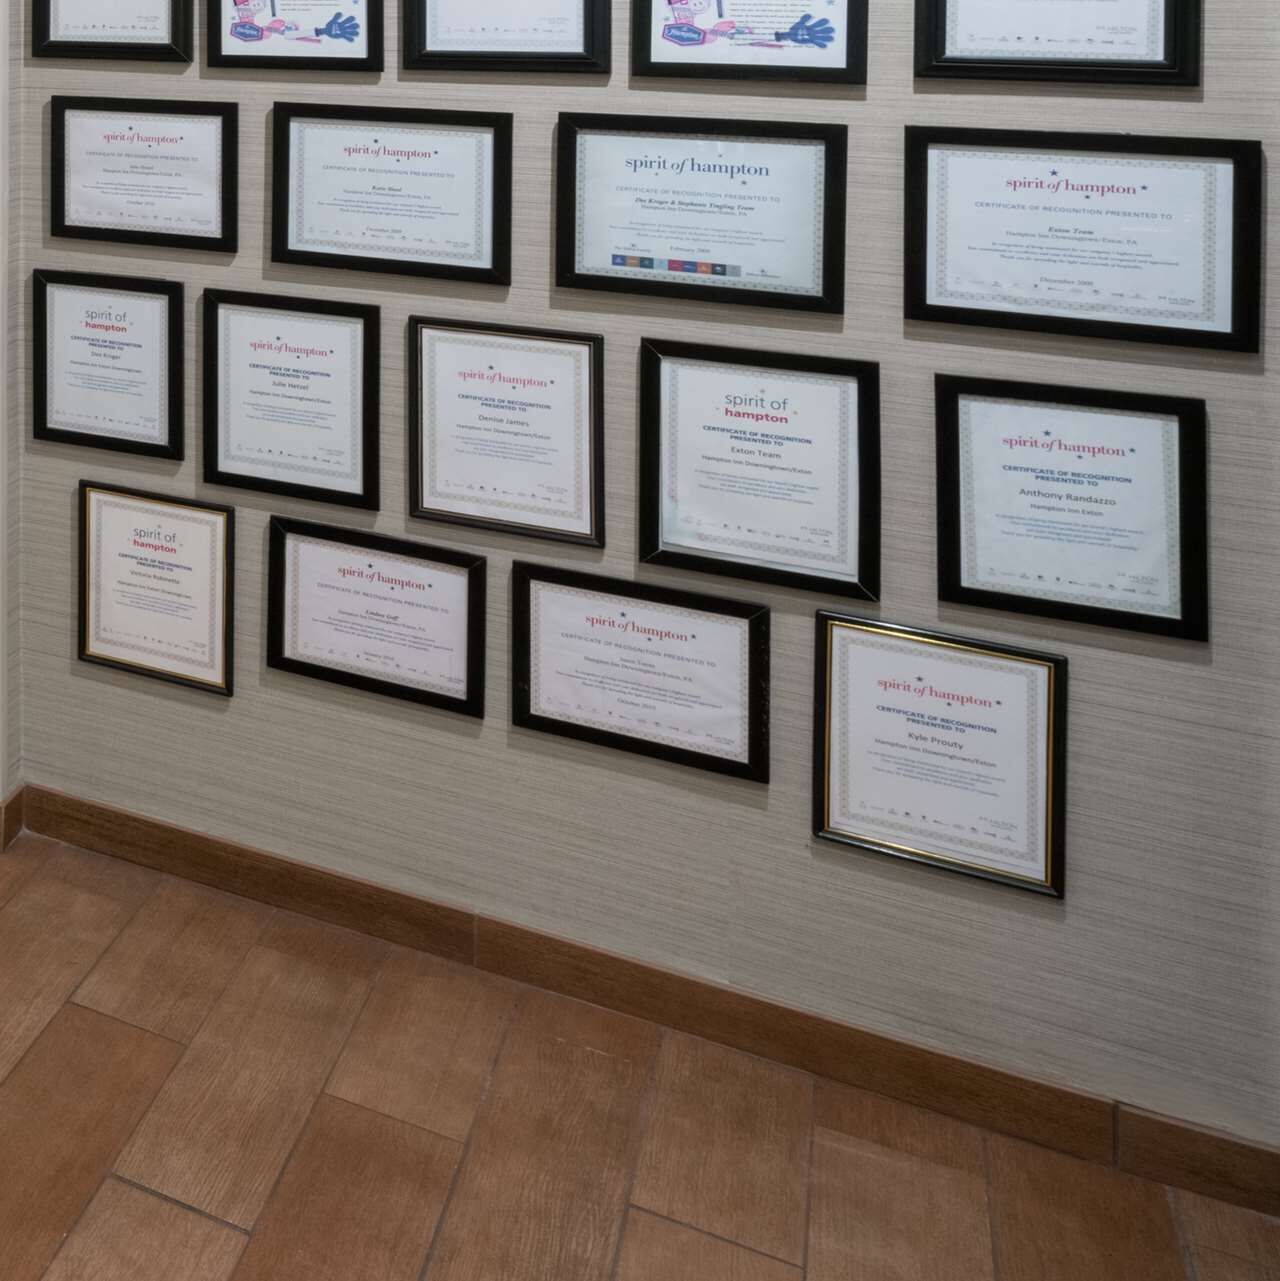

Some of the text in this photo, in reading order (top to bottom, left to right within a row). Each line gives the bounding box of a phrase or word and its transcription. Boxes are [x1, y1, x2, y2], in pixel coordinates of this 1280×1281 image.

[344, 145, 431, 160] spirit of hampton
[625, 156, 769, 178] spirit of hampton
[1005, 176, 1136, 197] spirit of hampton
[975, 201, 1026, 211] CERTIFICATE
[1043, 205, 1102, 216] RECOGNITION
[1106, 209, 1157, 219] PRESENTED
[85, 310, 126, 324] spirit of
[85, 321, 127, 333] hampton
[458, 370, 547, 388] spirit of hampton
[725, 393, 788, 411] spirit of
[725, 407, 788, 424] hampton
[703, 425, 747, 436] CERTIFICATE
[761, 433, 812, 444] RECOGNITION
[730, 435, 772, 446] PRESENTED
[731, 446, 781, 459] Exton Team
[1002, 436, 1126, 457] spirit of hampton
[1002, 464, 1055, 476] CERTIFICATE
[1071, 471, 1132, 484] RECOGNITION
[1034, 475, 1084, 485] PRESENTED
[1019, 488, 1116, 506] Anthony Randazzo
[133, 528, 176, 543] spirit of
[133, 539, 177, 554] hampton
[585, 615, 688, 642] spirit of hampton
[877, 677, 992, 708] spirit of hampton
[876, 705, 926, 719] CERTIFICATE
[940, 717, 997, 735] RECOGNITION
[906, 717, 953, 732] PRESENTED
[908, 731, 964, 751] Kyle Prouty
